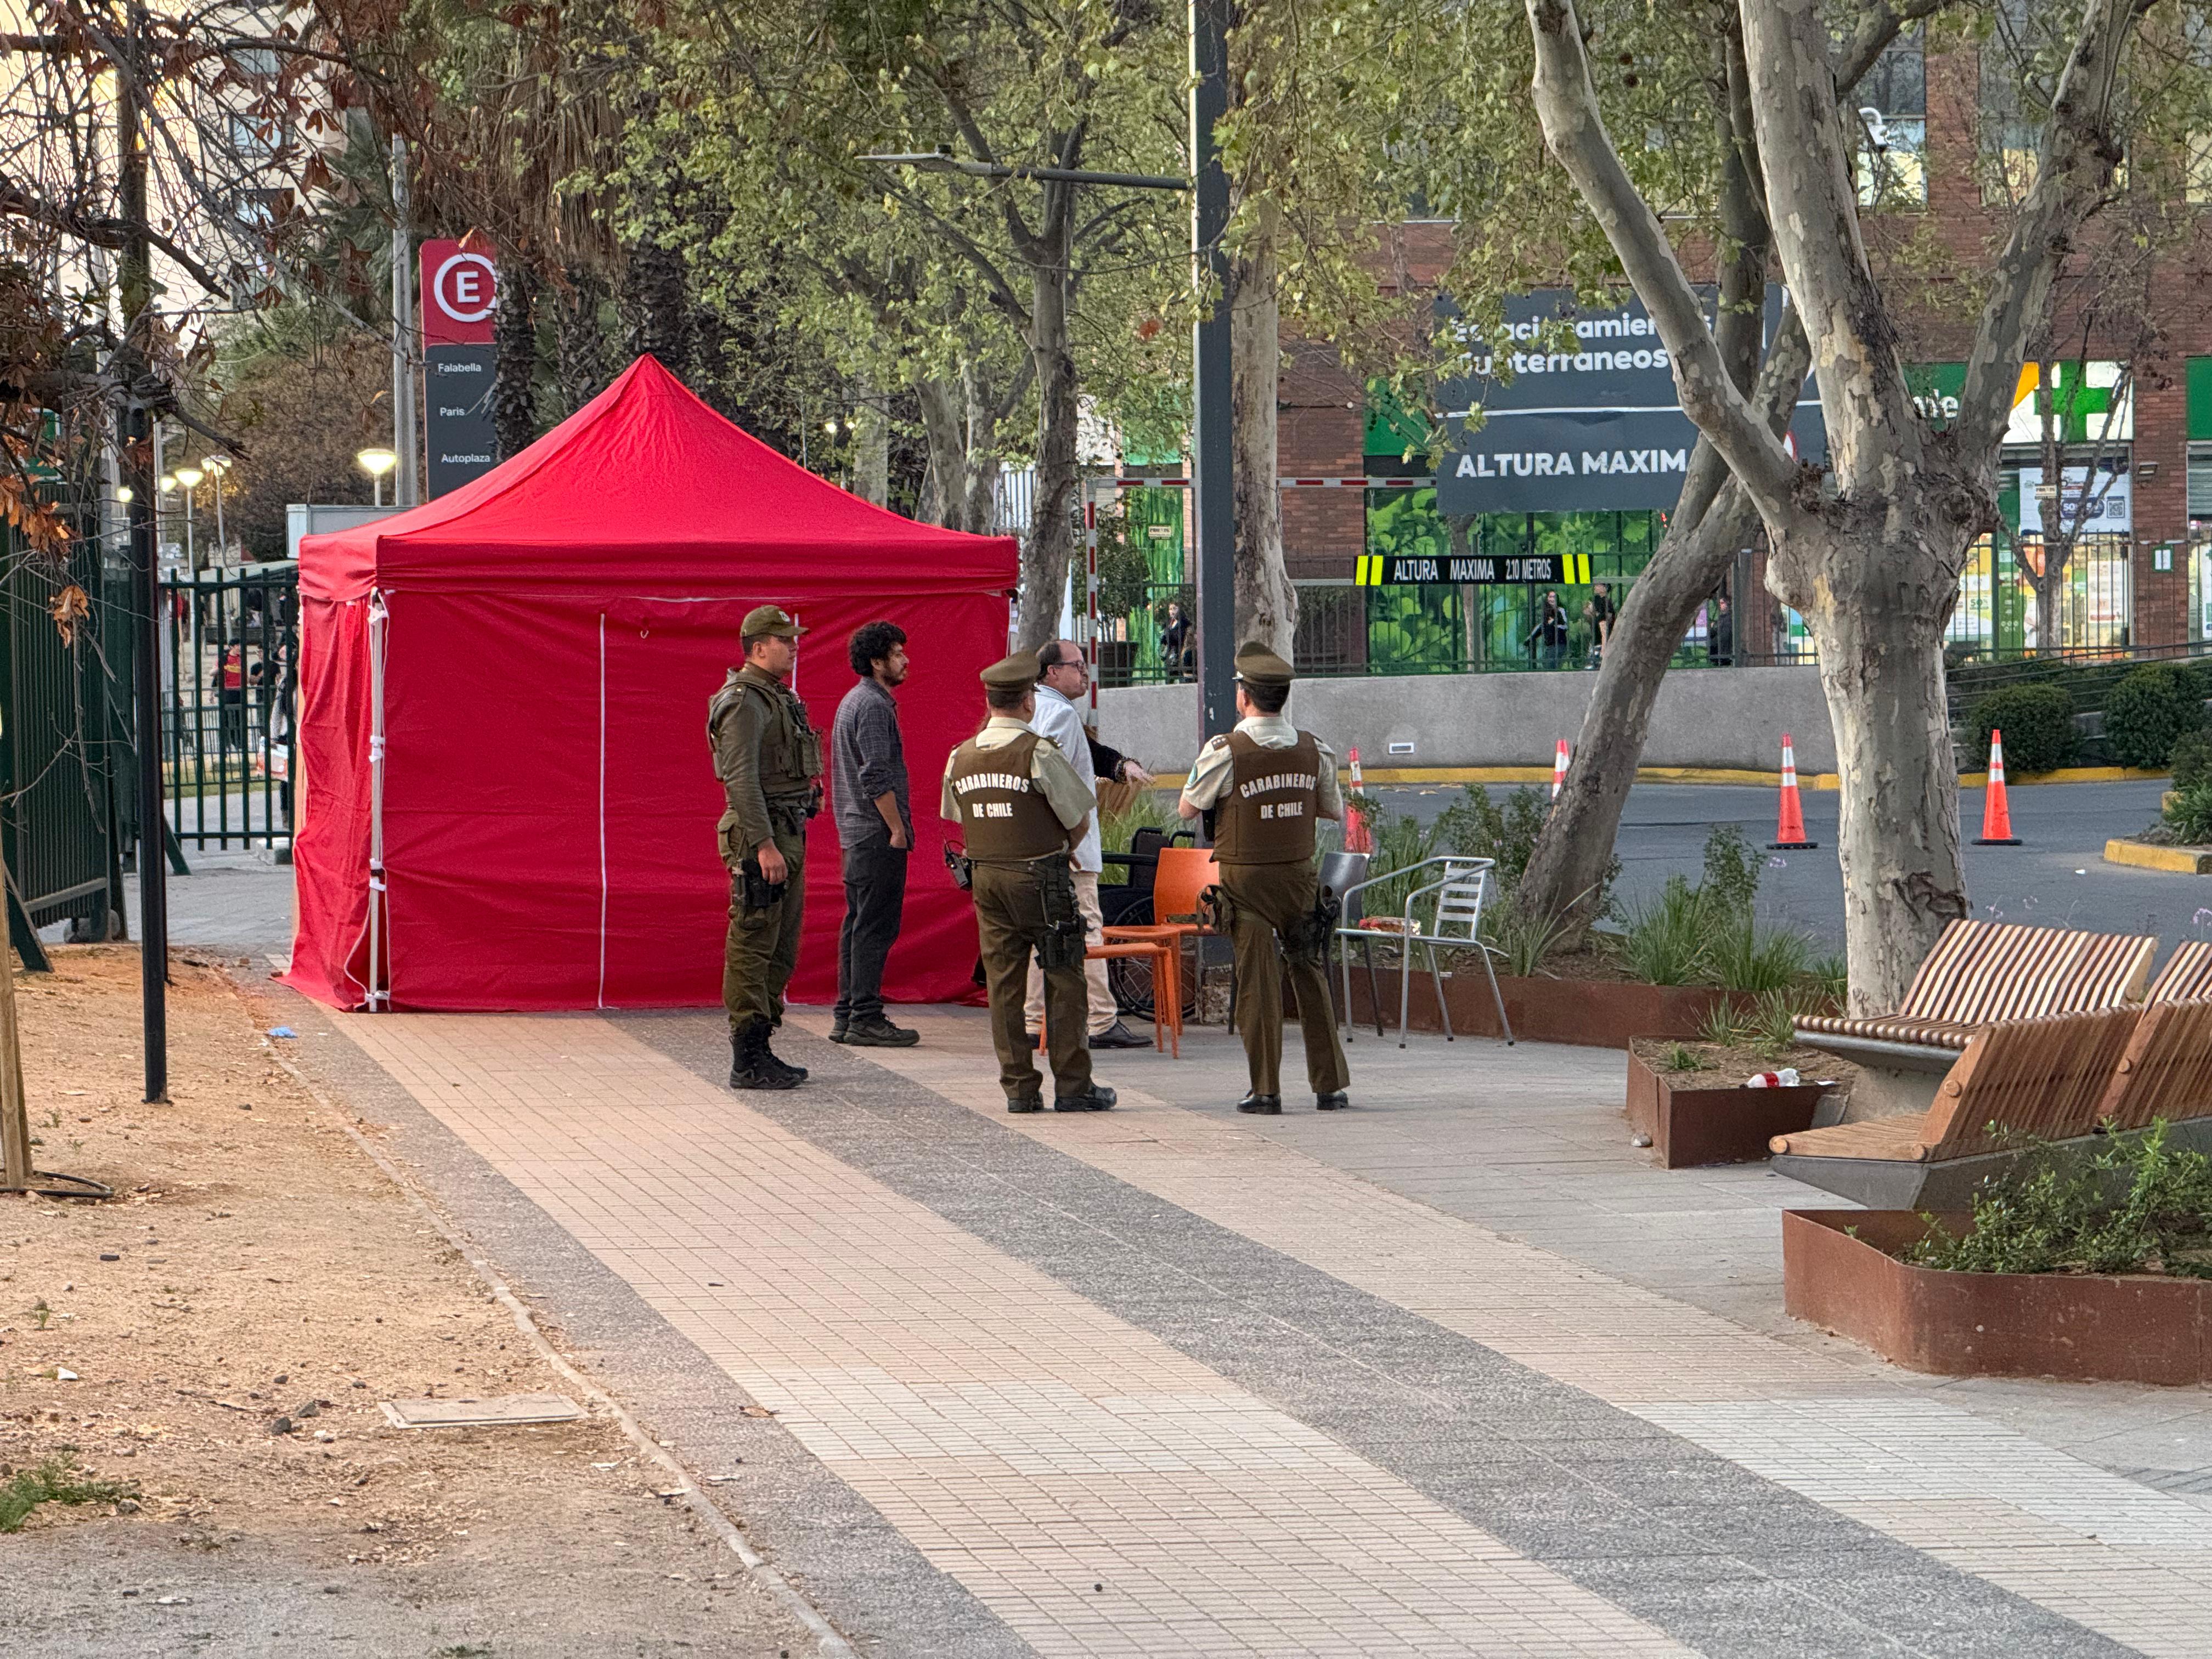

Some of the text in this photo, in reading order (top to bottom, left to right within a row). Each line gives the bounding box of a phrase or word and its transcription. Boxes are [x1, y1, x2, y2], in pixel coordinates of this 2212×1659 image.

[456, 271, 481, 303] E
[438, 363, 482, 373] Falabella
[1459, 348, 1668, 375] uterraneos
[440, 408, 465, 416] Paris
[441, 454, 491, 464] Autoplaza
[1455, 449, 1688, 478] ALTURA MAXIM
[1393, 558, 1551, 580] ALTURA MAXIMA 2.10 METROS
[955, 773, 1030, 794] CARABINEROS
[1240, 772, 1316, 798] CARABINEROS
[972, 803, 1013, 817] DE CHILE
[1261, 802, 1302, 819] DE CHILE
